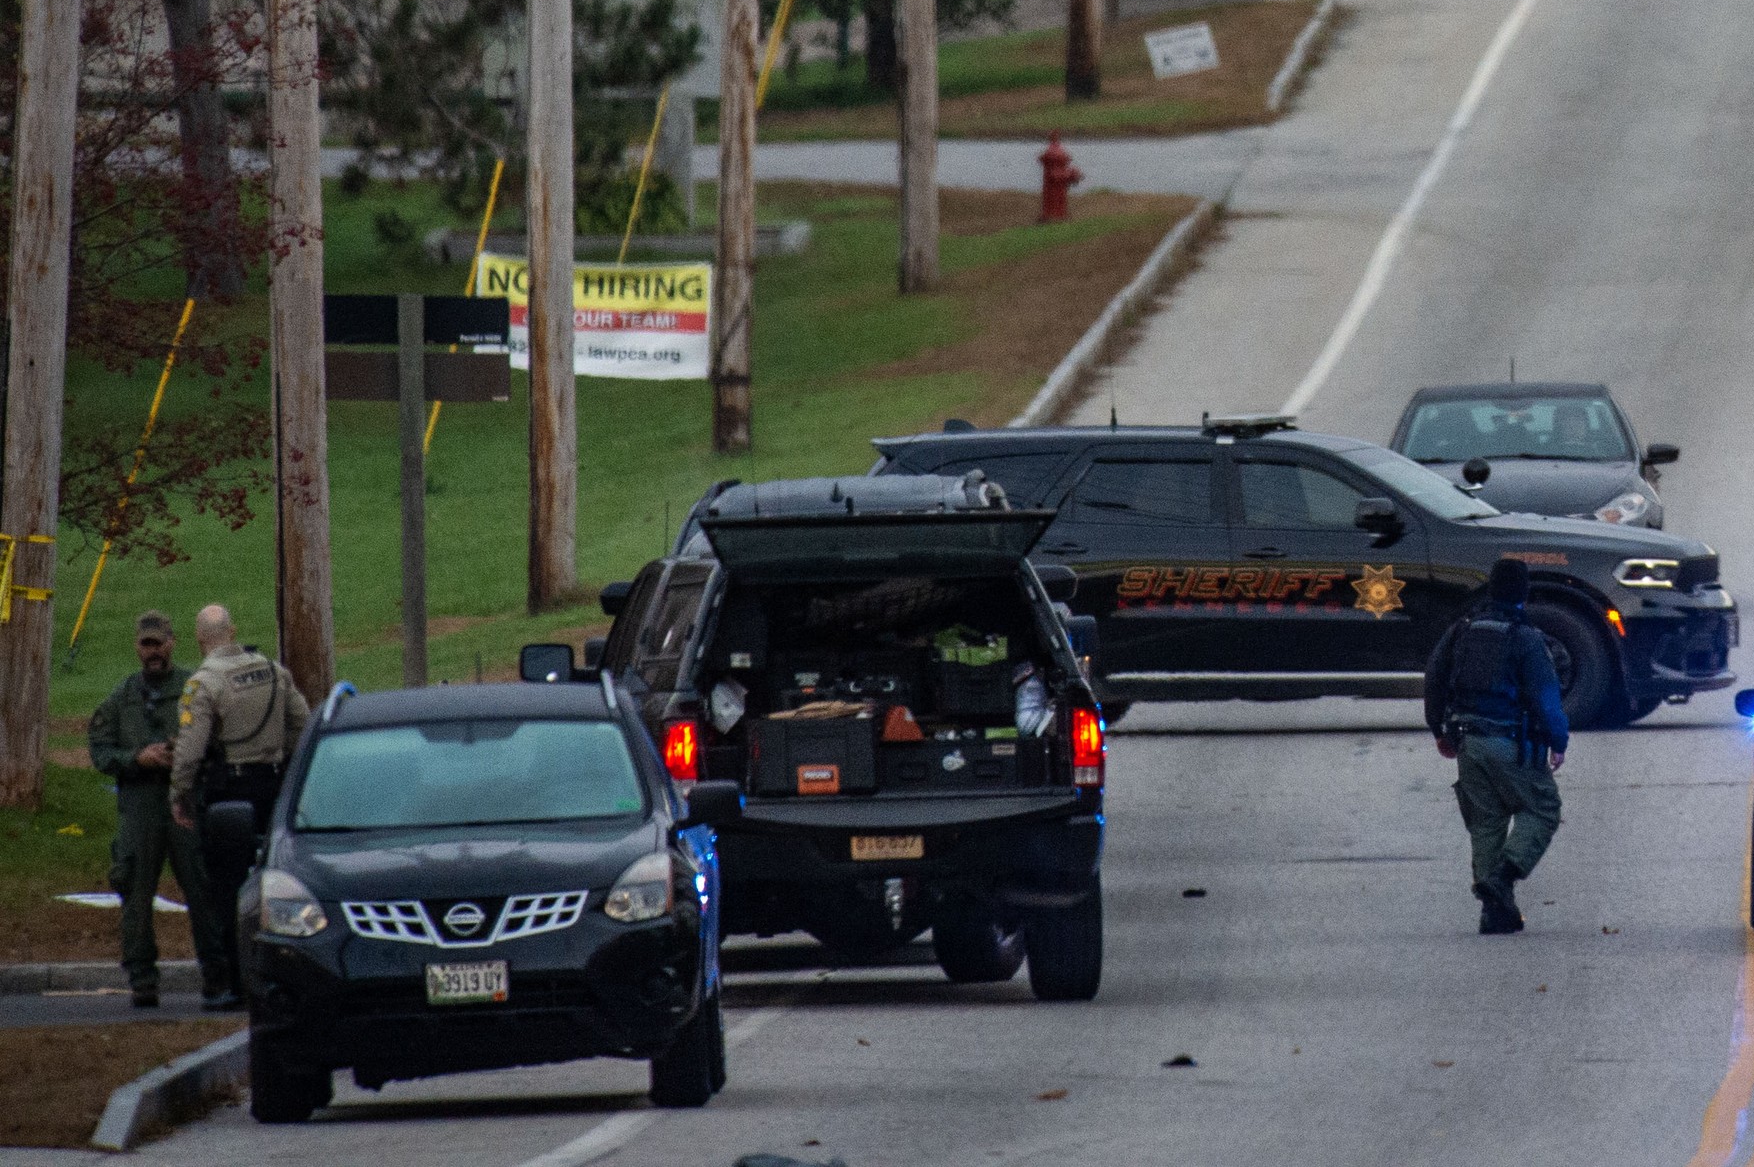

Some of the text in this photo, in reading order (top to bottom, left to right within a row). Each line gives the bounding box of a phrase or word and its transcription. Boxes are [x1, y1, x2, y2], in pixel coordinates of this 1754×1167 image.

[488, 265, 704, 302] NO HIRING
[573, 311, 678, 330] OUR TEAM!
[1117, 565, 1346, 600] SHERIFF
